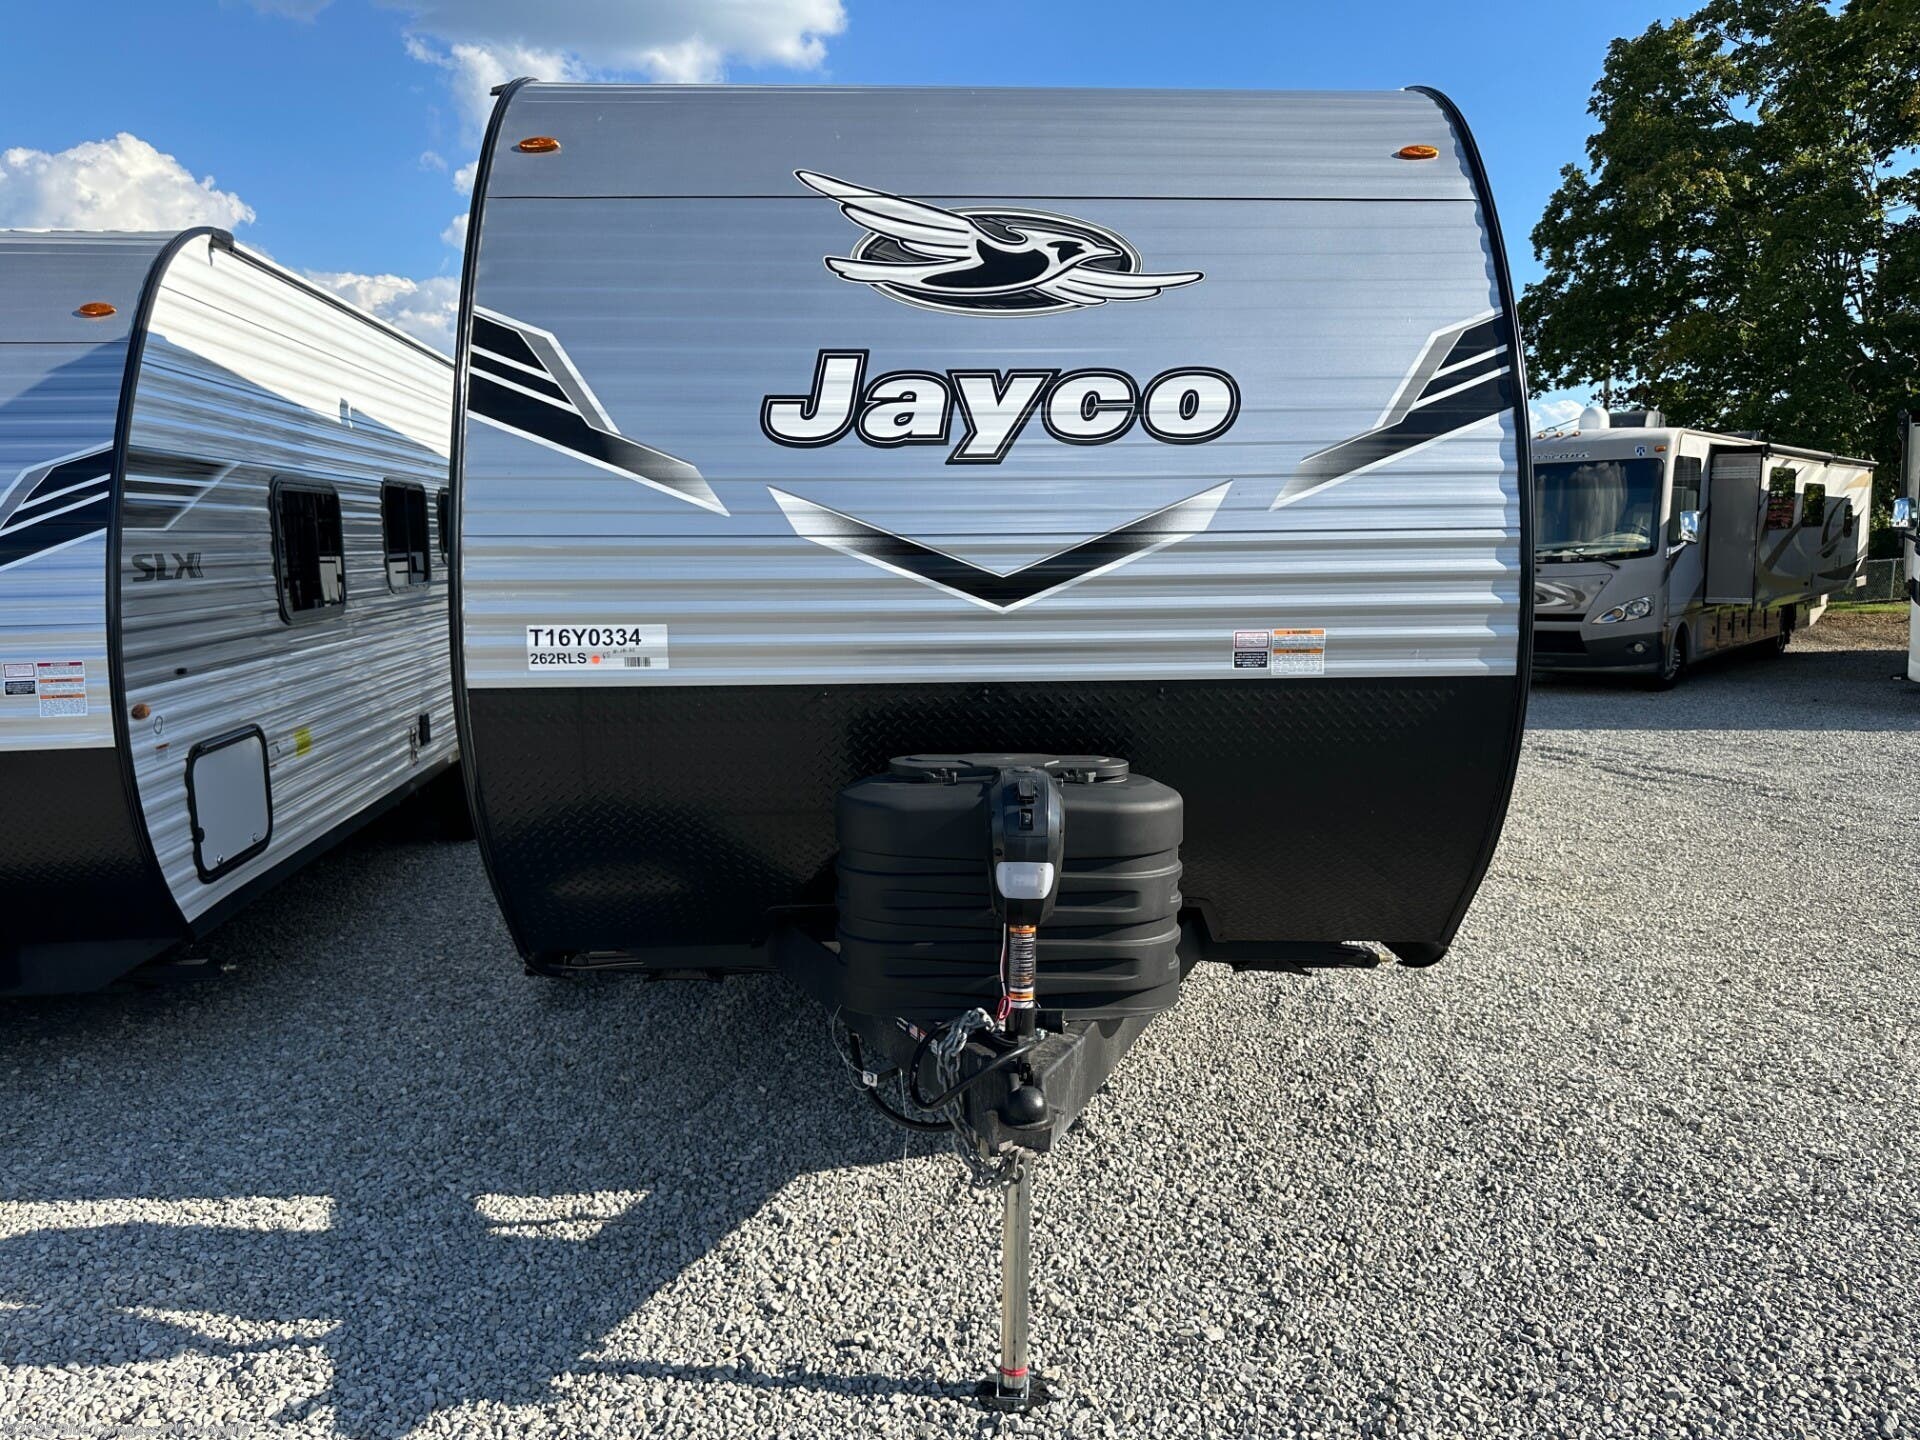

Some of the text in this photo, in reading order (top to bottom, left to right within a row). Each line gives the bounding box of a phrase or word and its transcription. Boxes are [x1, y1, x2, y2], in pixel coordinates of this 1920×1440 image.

[760, 348, 1241, 465] Jayco
[132, 552, 204, 582] SLX
[529, 628, 642, 647] T16Y0334
[530, 652, 587, 665] 262RLS
